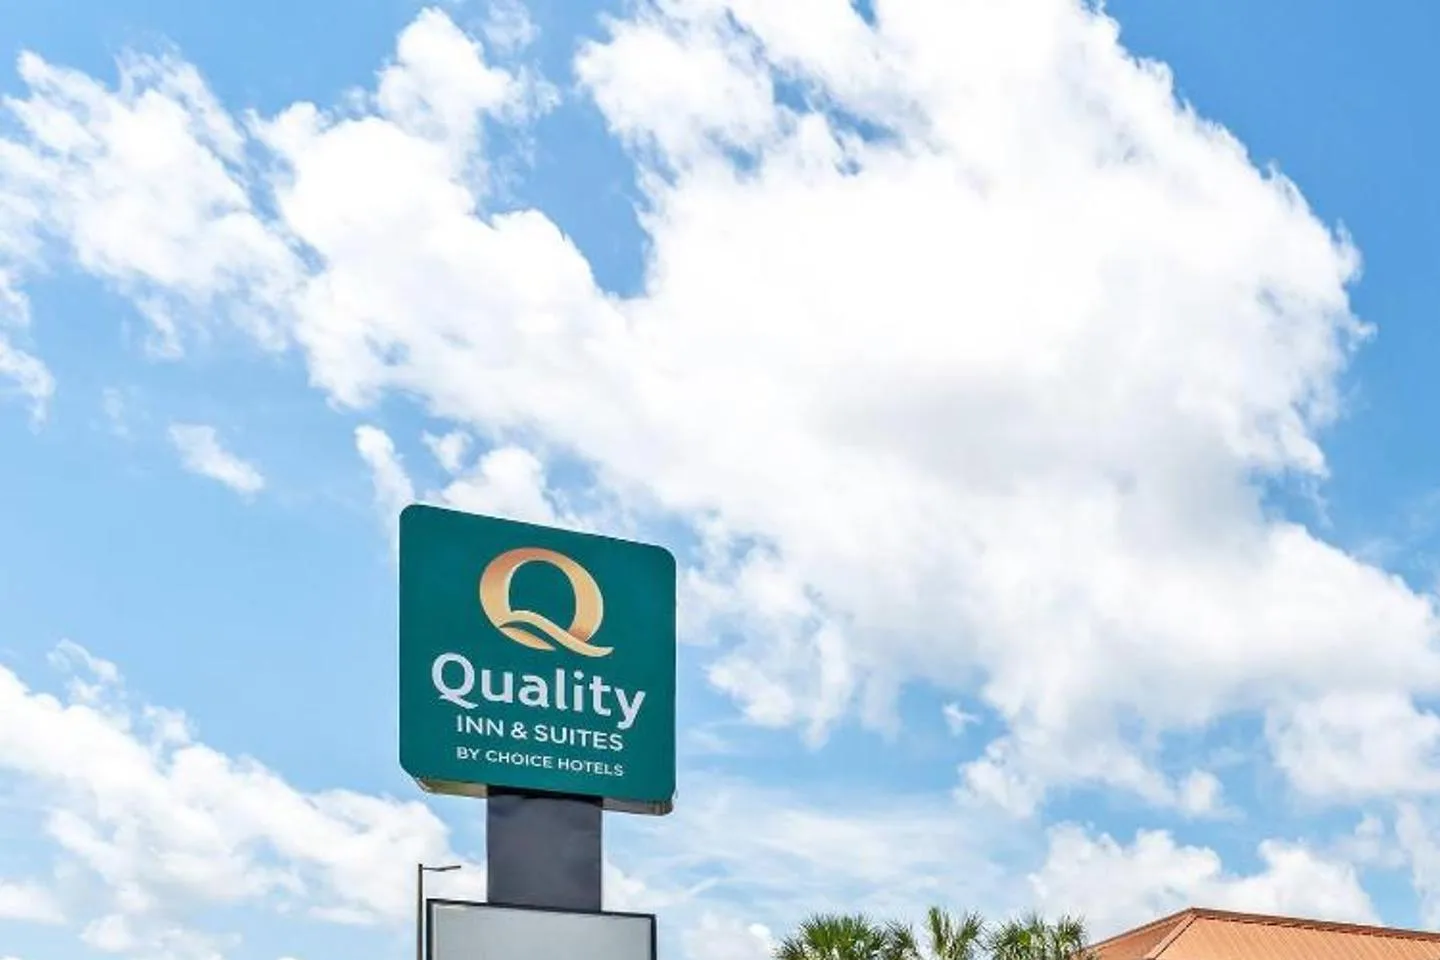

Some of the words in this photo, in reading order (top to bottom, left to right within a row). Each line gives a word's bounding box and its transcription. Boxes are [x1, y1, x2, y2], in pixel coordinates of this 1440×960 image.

[431, 652, 646, 730] Quality
[456, 714, 504, 737] INN
[510, 721, 528, 740] &
[534, 723, 624, 751] SUITES
[456, 746, 480, 761] BY
[485, 750, 553, 769] CHOICE
[557, 758, 624, 777] HOTELS
